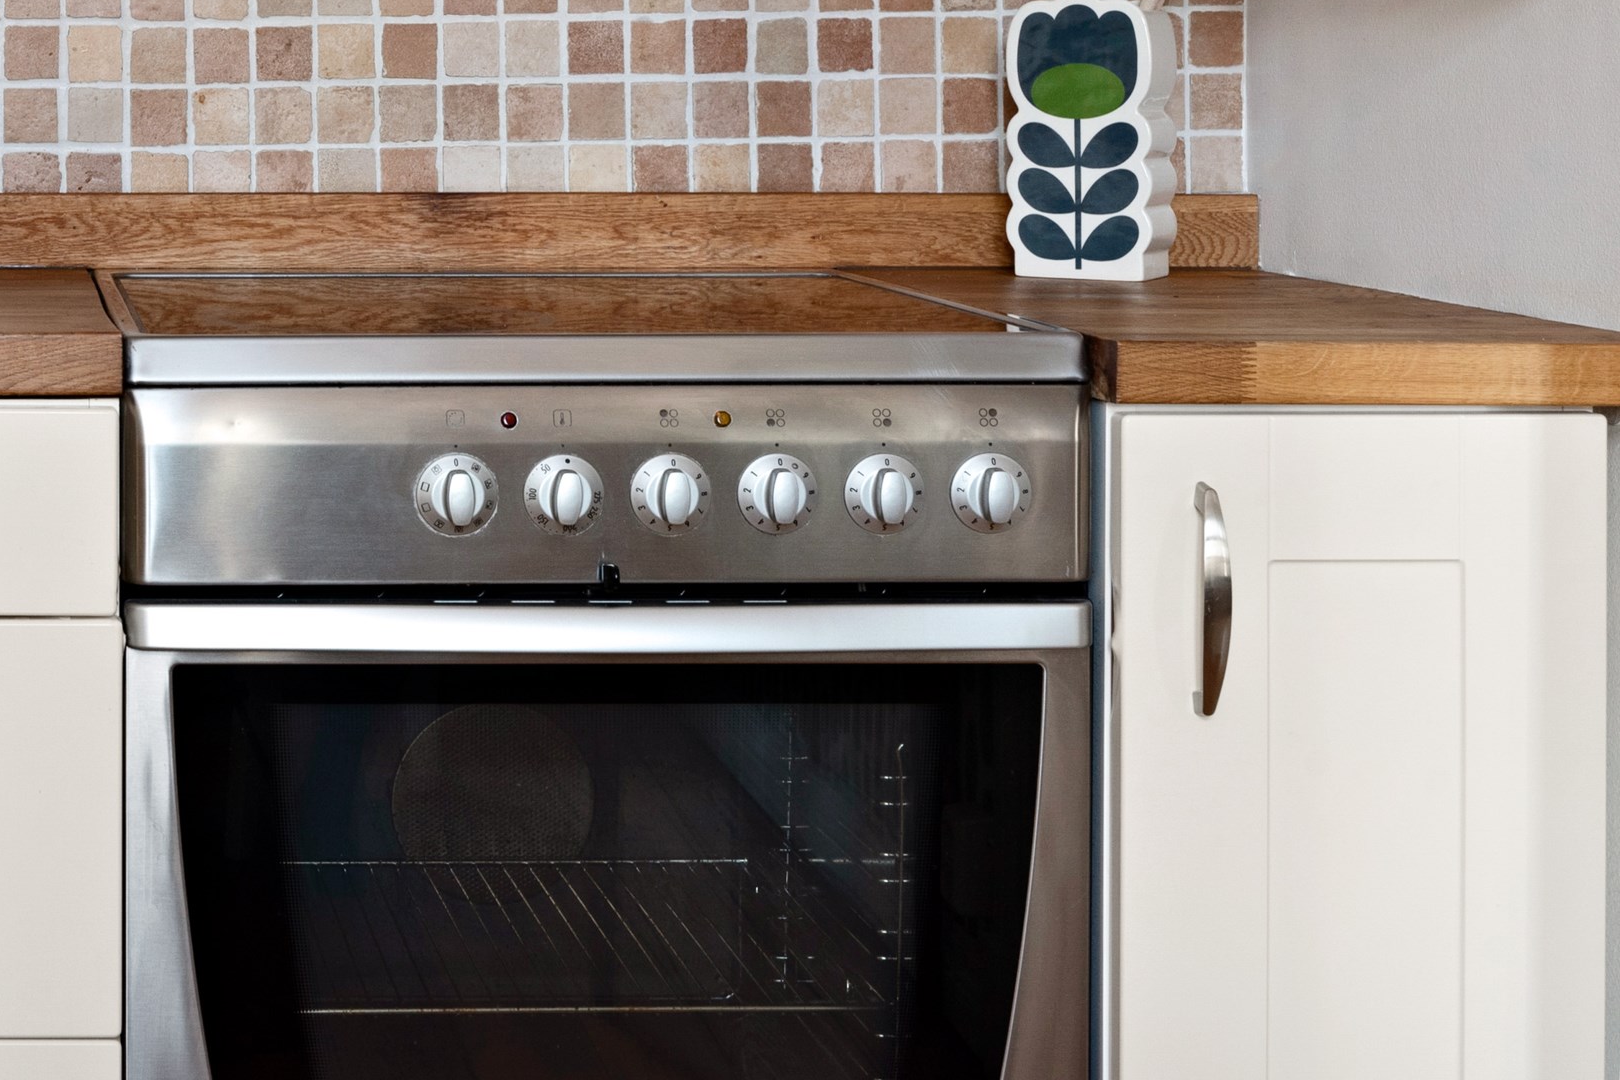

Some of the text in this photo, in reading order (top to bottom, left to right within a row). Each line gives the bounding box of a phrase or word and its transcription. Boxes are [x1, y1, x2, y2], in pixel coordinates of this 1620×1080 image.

[453, 458, 459, 467] 0
[541, 463, 551, 474] 50
[528, 488, 537, 500] 100
